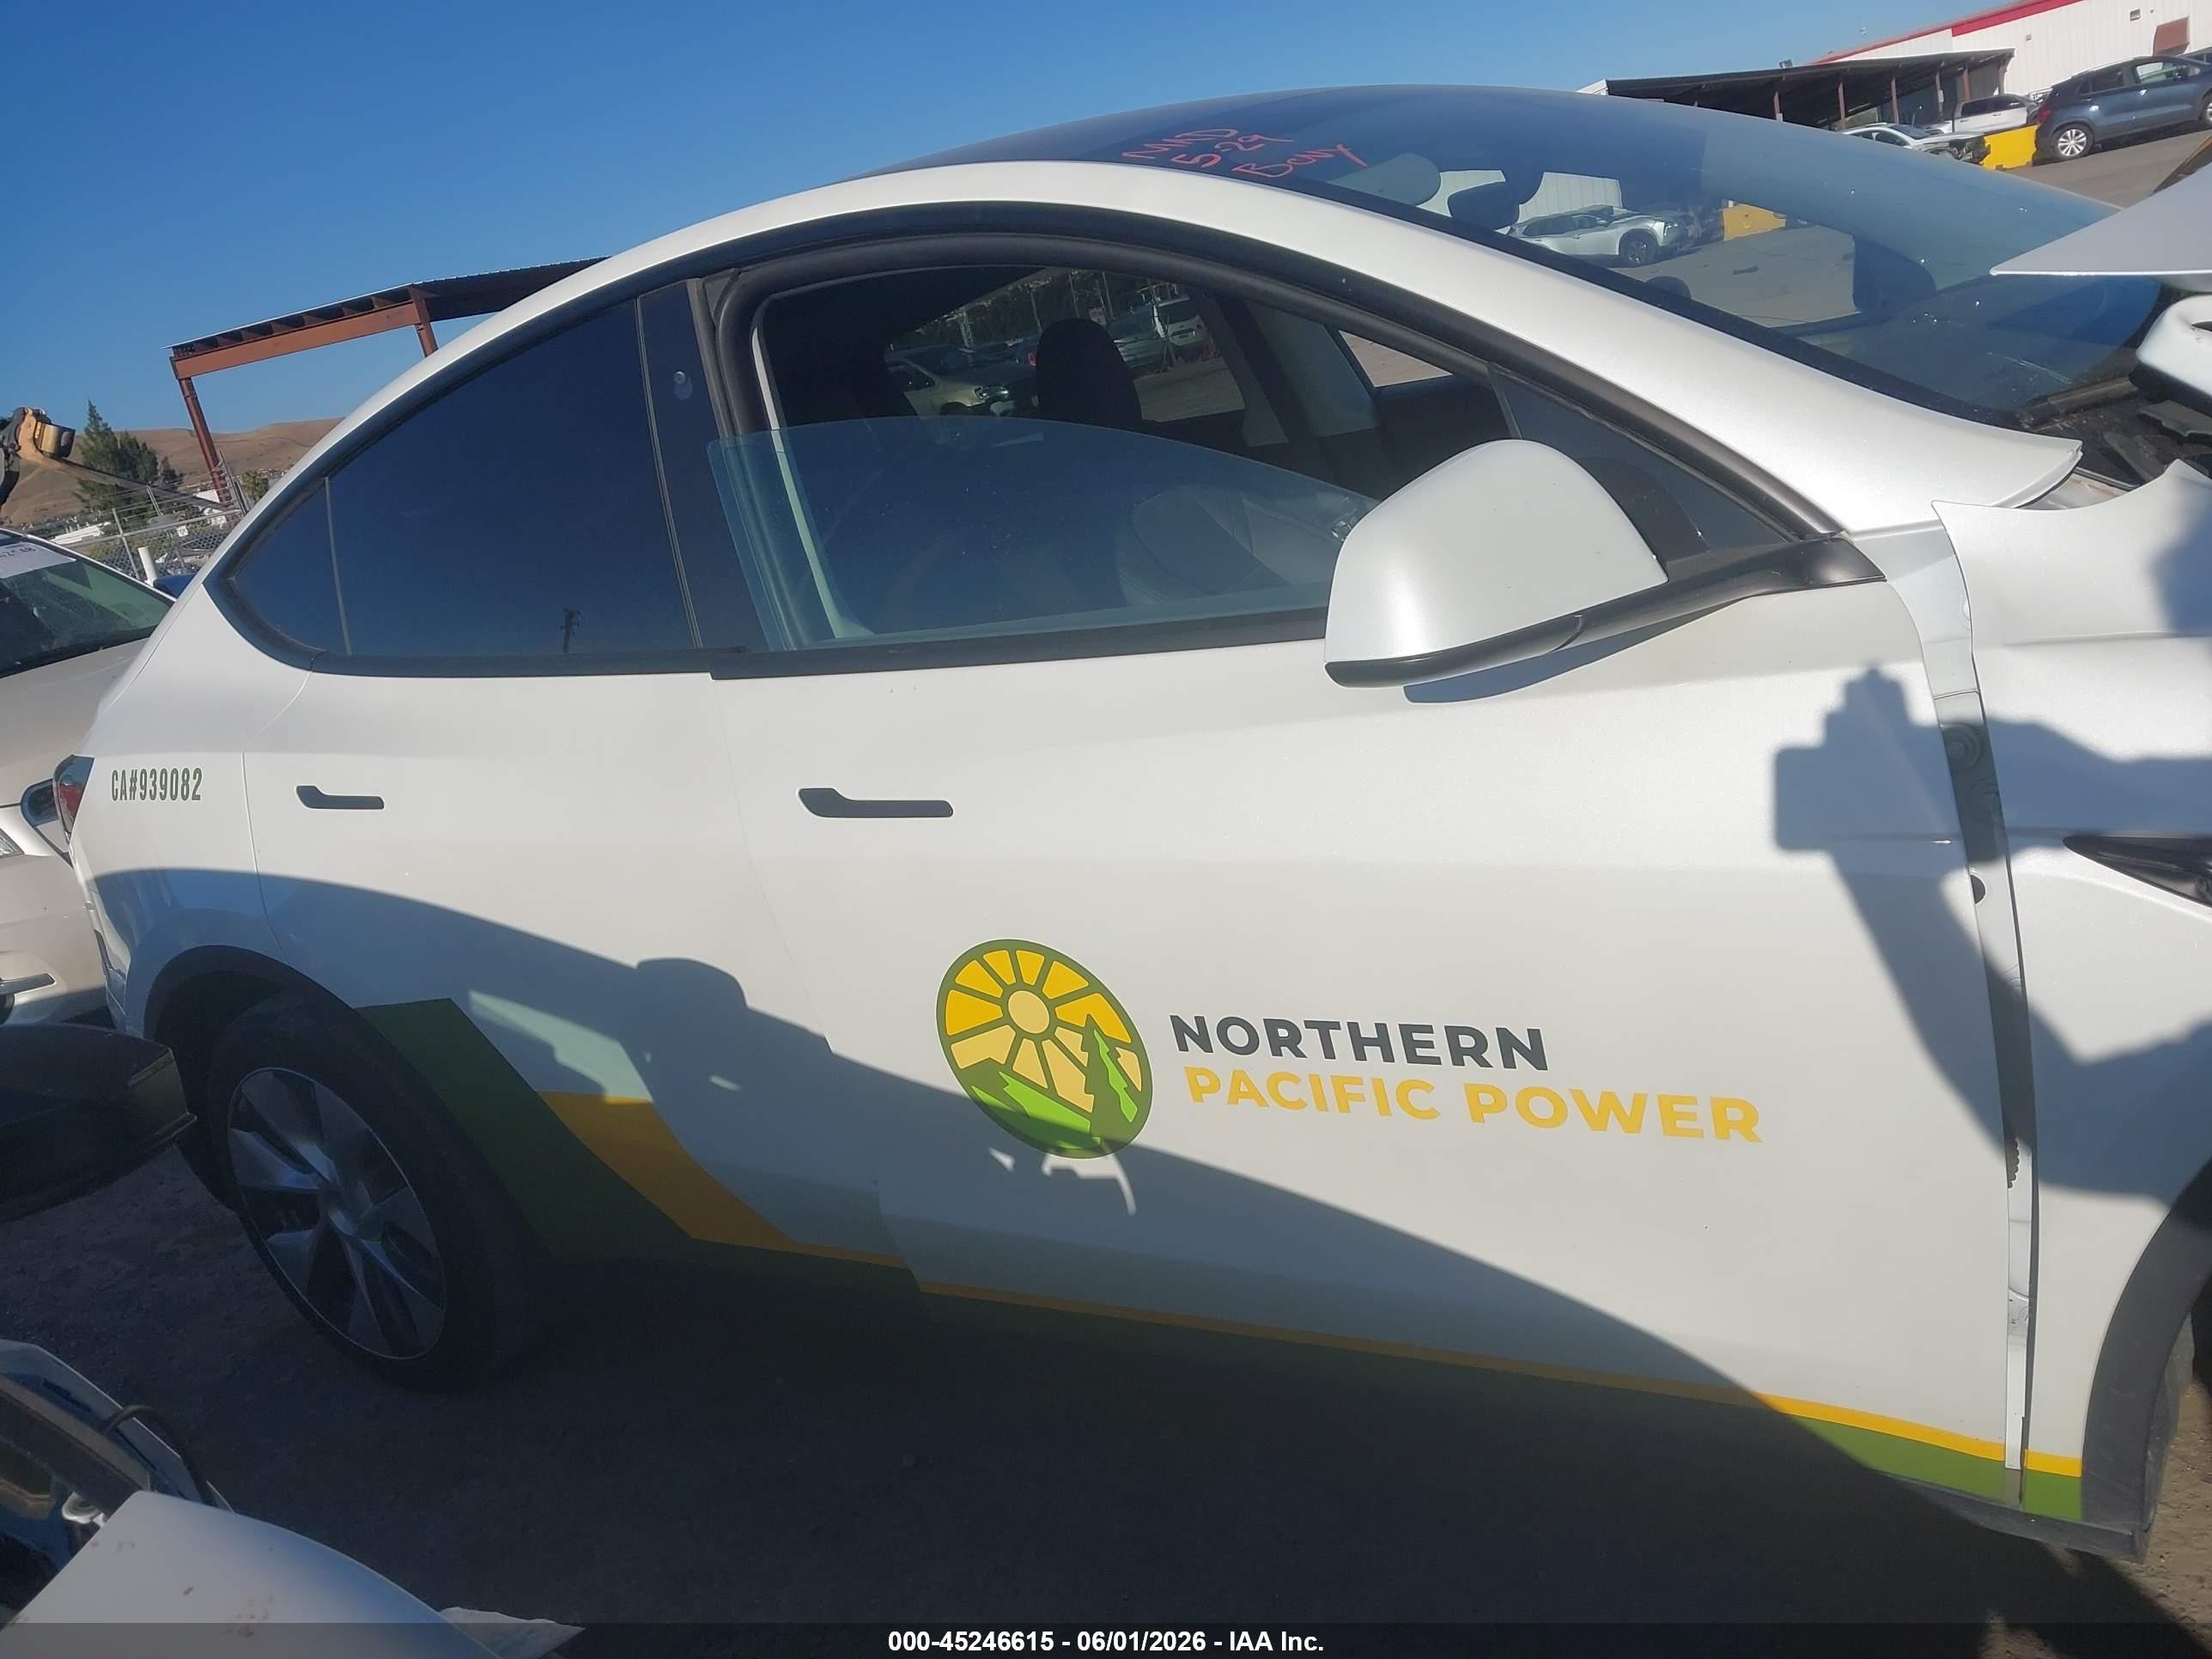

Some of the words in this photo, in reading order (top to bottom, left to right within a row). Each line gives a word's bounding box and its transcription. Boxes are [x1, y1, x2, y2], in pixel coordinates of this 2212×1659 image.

[111, 768, 203, 801] CA#939082
[1170, 1014, 1548, 1072] NORTHERN
[1183, 1066, 1441, 1121] PACIFIC
[1463, 1083, 1763, 1144] POWER
